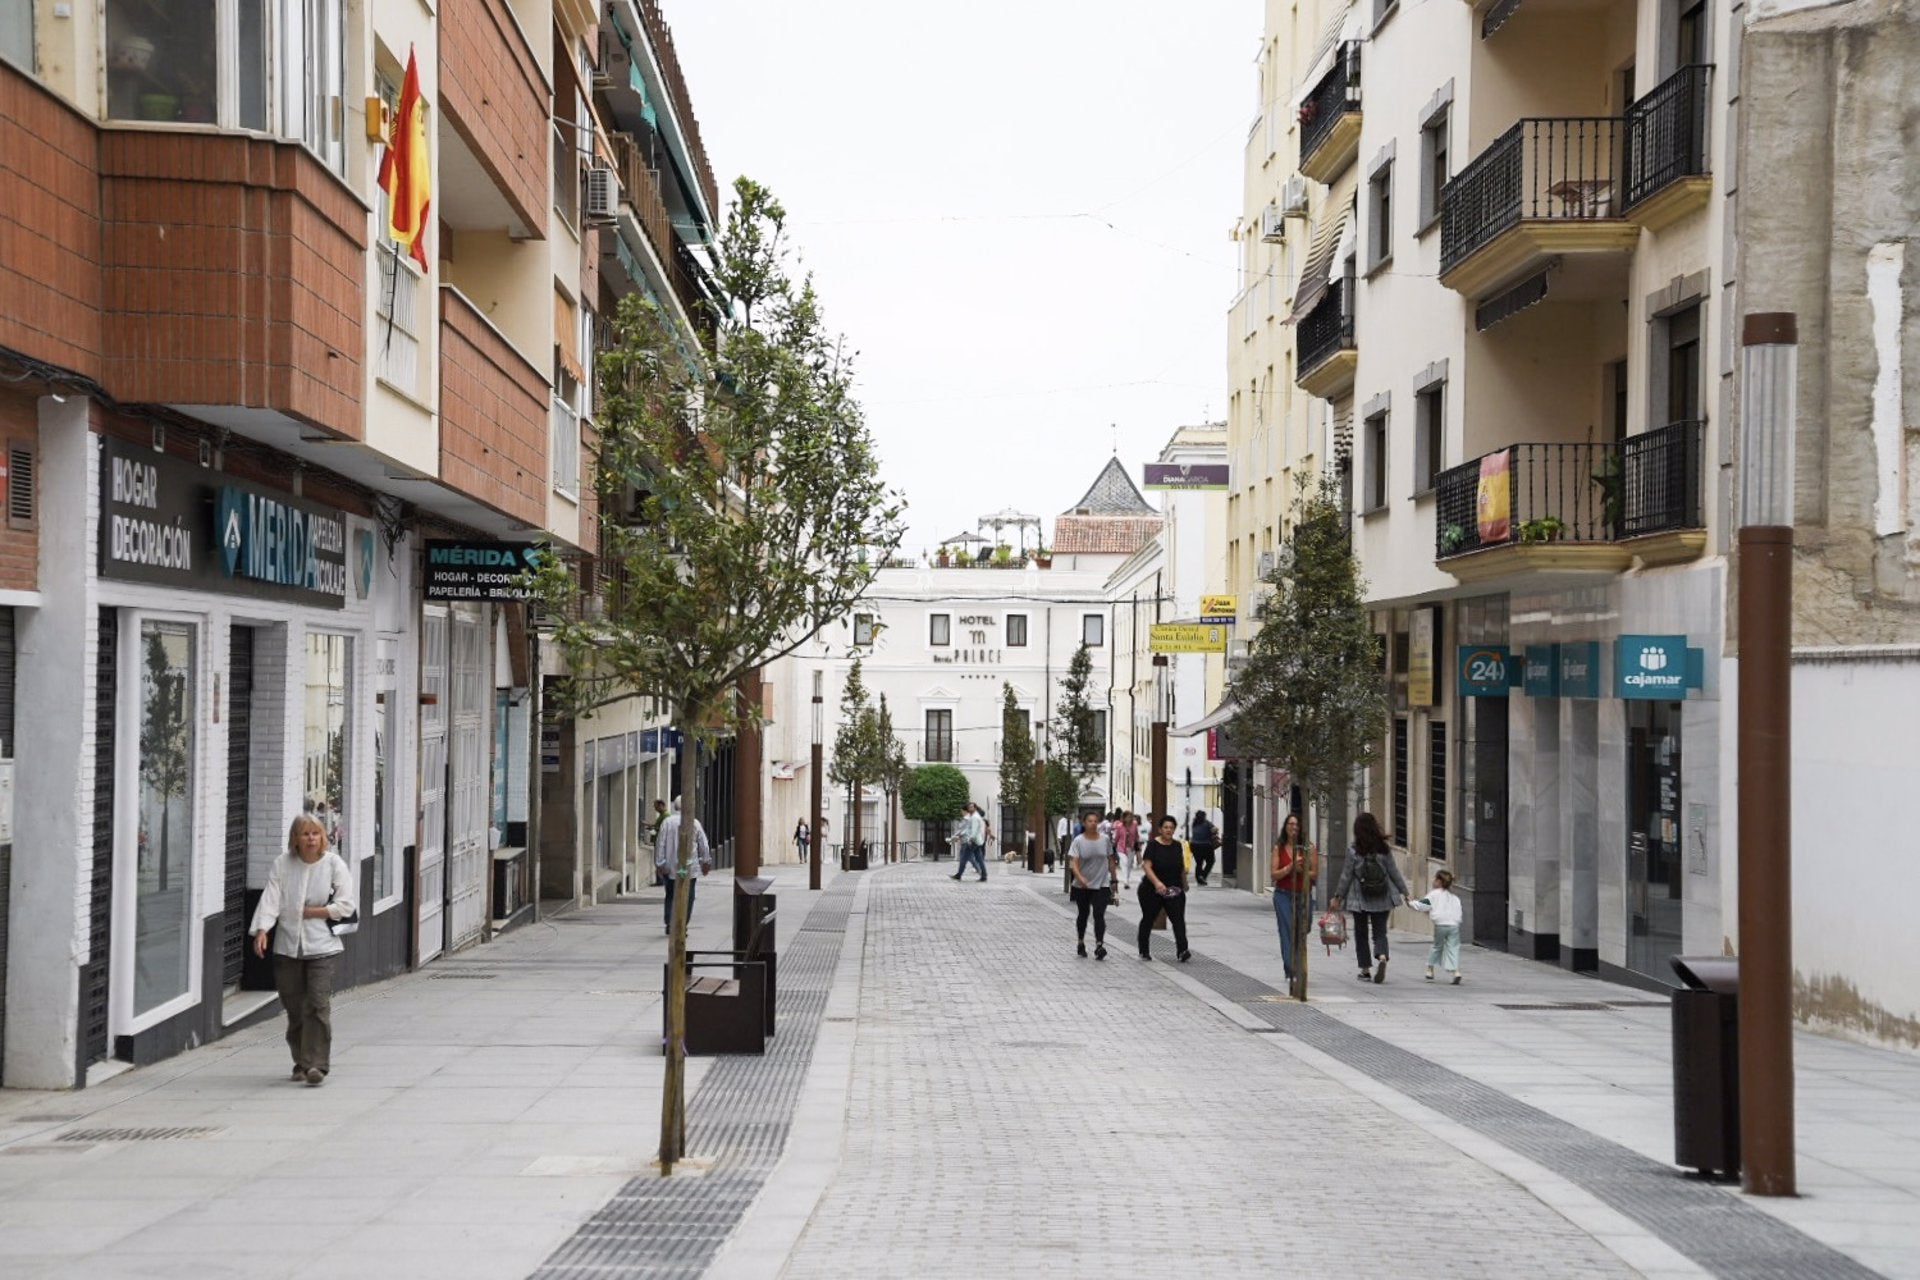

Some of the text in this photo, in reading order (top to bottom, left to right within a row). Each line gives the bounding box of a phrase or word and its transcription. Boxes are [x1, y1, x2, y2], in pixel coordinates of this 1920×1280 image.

[112, 457, 157, 509] HOGAR
[111, 515, 191, 571] DECORACIÓN
[430, 545, 517, 567] MÉRIDA
[434, 571, 468, 582] HOGAR
[429, 585, 481, 598] PAPELERÍA
[959, 615, 996, 626] HOTEL
[1151, 632, 1174, 641] Santa
[954, 649, 1001, 663] PALACE
[1624, 672, 1682, 688] cajamar
